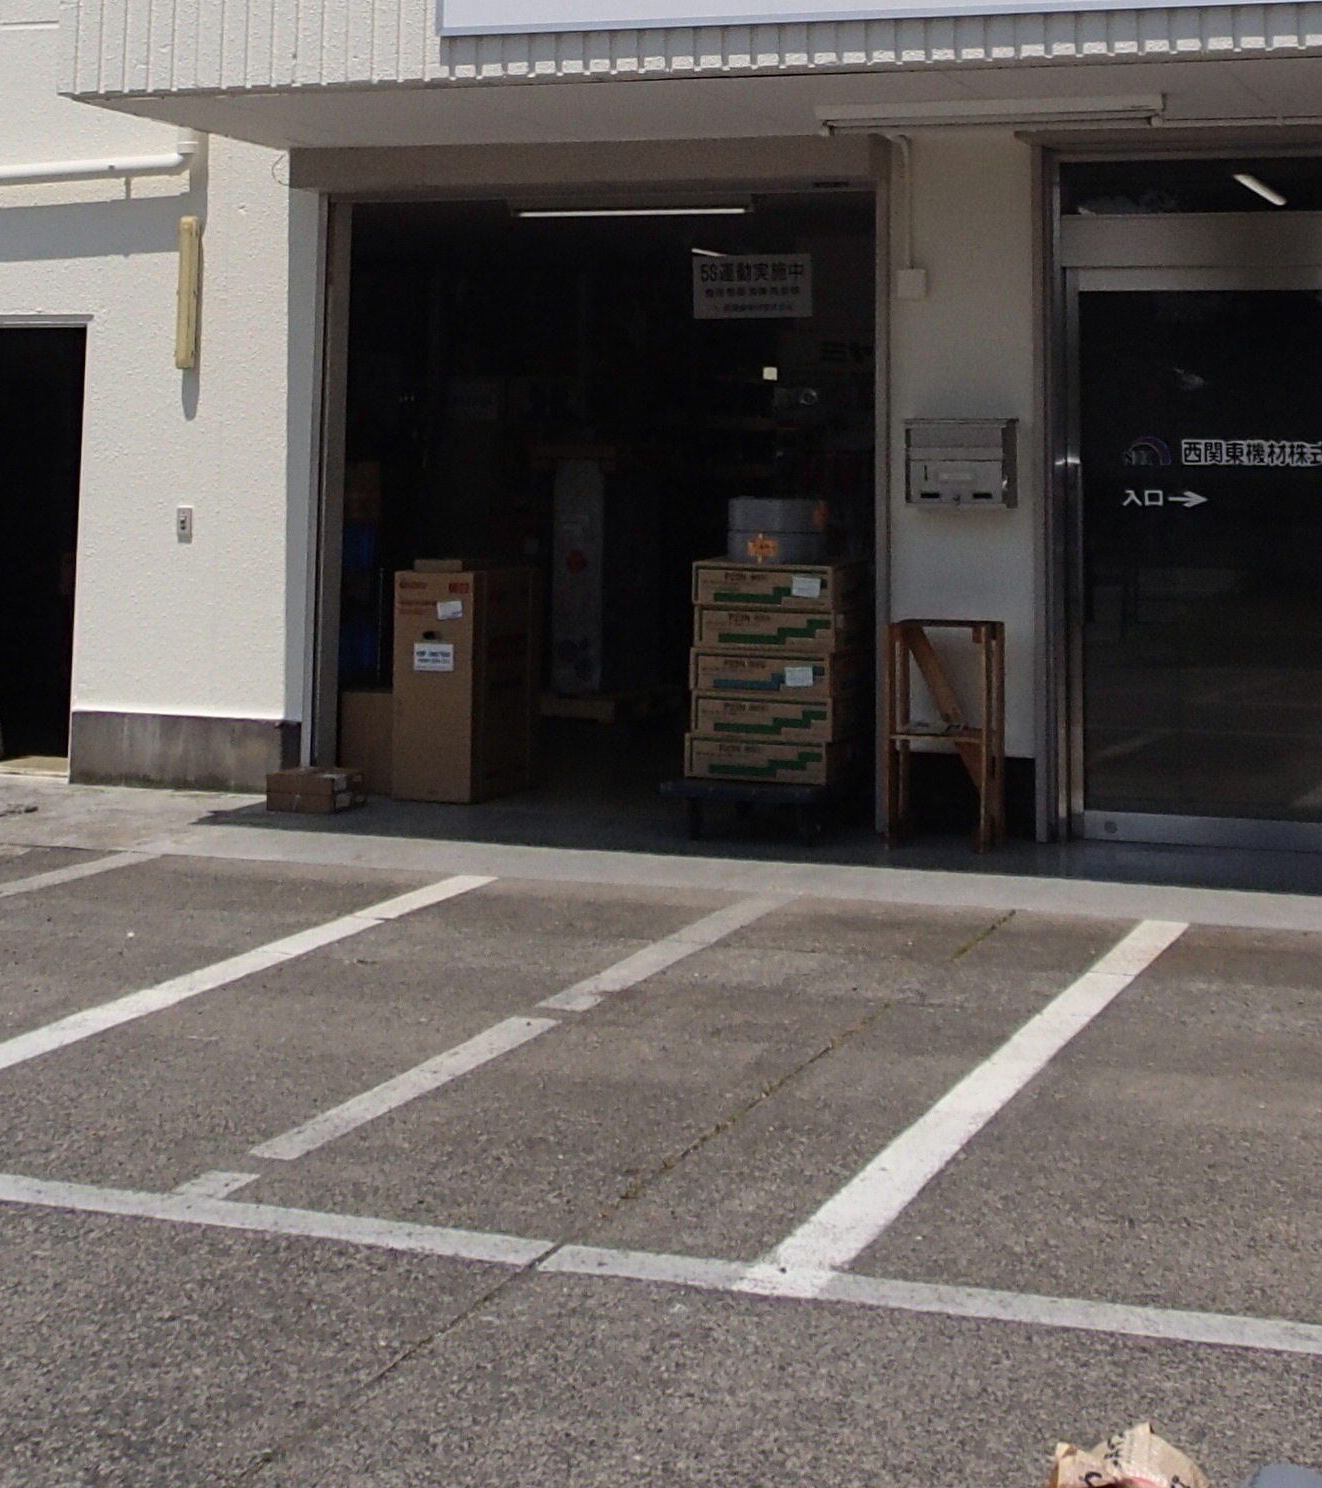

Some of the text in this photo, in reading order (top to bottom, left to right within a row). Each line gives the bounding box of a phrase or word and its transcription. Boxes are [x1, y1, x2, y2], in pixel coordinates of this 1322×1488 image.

[700, 261, 804, 282] 5S運動実施中
[1122, 490, 1164, 507] 入口
